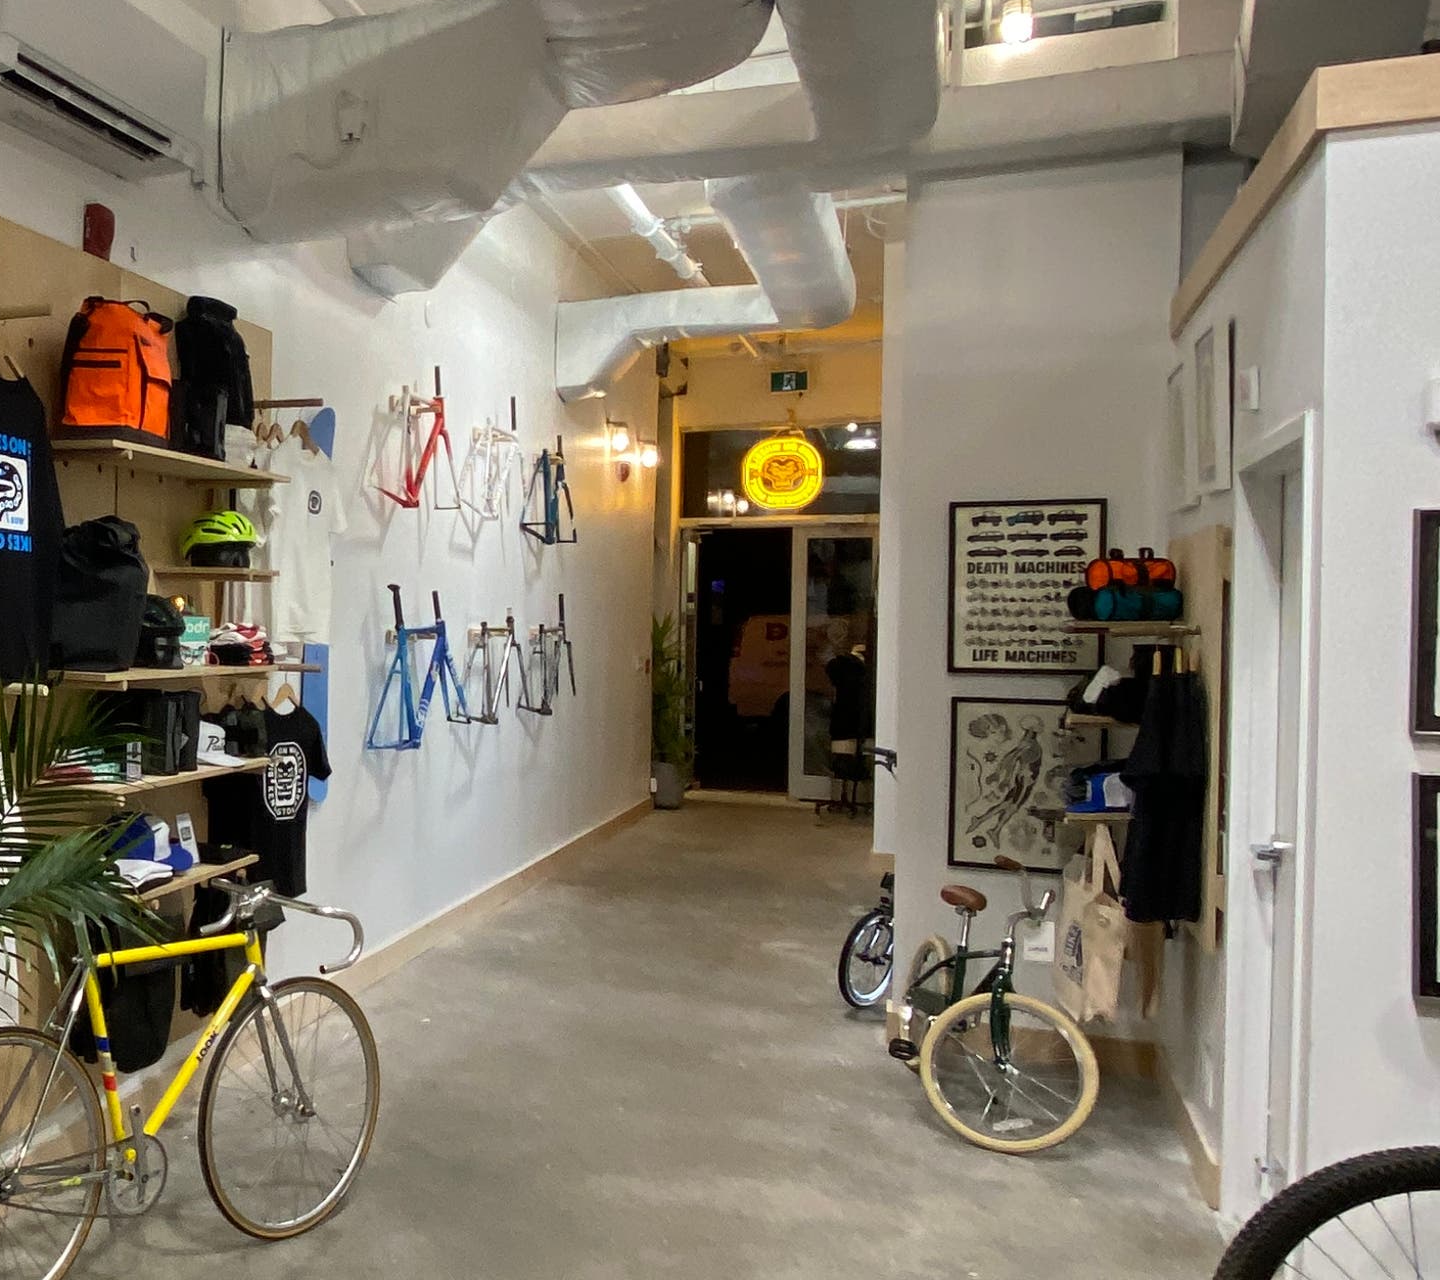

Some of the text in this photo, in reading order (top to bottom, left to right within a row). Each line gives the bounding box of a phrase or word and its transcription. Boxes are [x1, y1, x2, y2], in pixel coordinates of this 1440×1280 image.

[966, 561, 1087, 574] DEATH MACHINES
[972, 649, 1078, 664] LIFE MACHINES
[196, 1030, 219, 1063] LOOK
